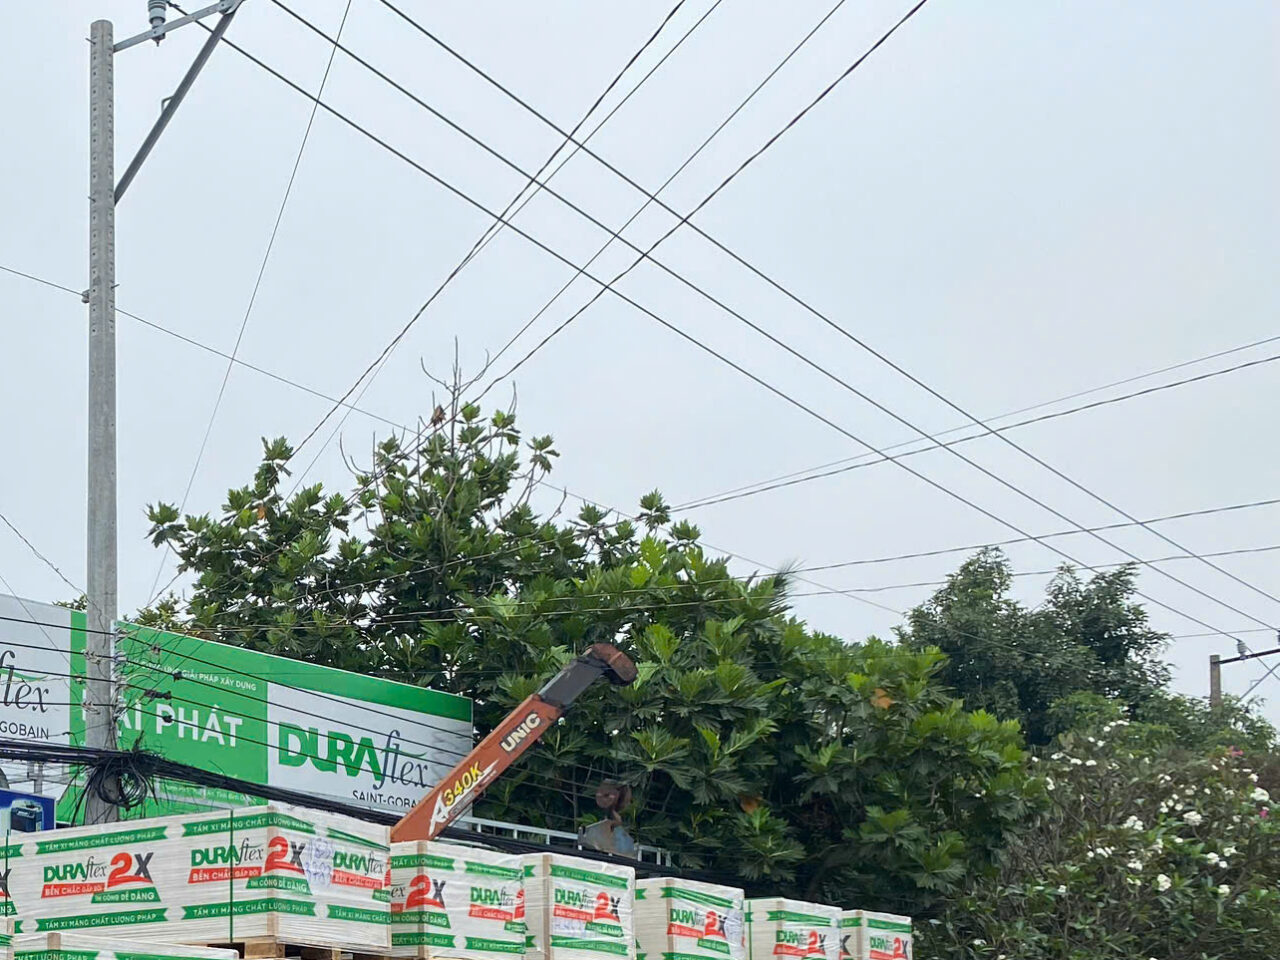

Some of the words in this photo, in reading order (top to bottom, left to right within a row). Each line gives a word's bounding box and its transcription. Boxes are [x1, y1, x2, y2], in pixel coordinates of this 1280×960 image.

[500, 712, 541, 752] UNIC
[278, 721, 429, 790] DURAflex
[352, 790, 419, 808] SAINT-GOBA
[443, 761, 483, 806] 340K
[43, 856, 107, 882] DURAflex
[107, 852, 154, 888] 2X
[191, 837, 263, 866] DURAflex
[264, 836, 306, 875] 2X
[406, 874, 446, 909] 2X
